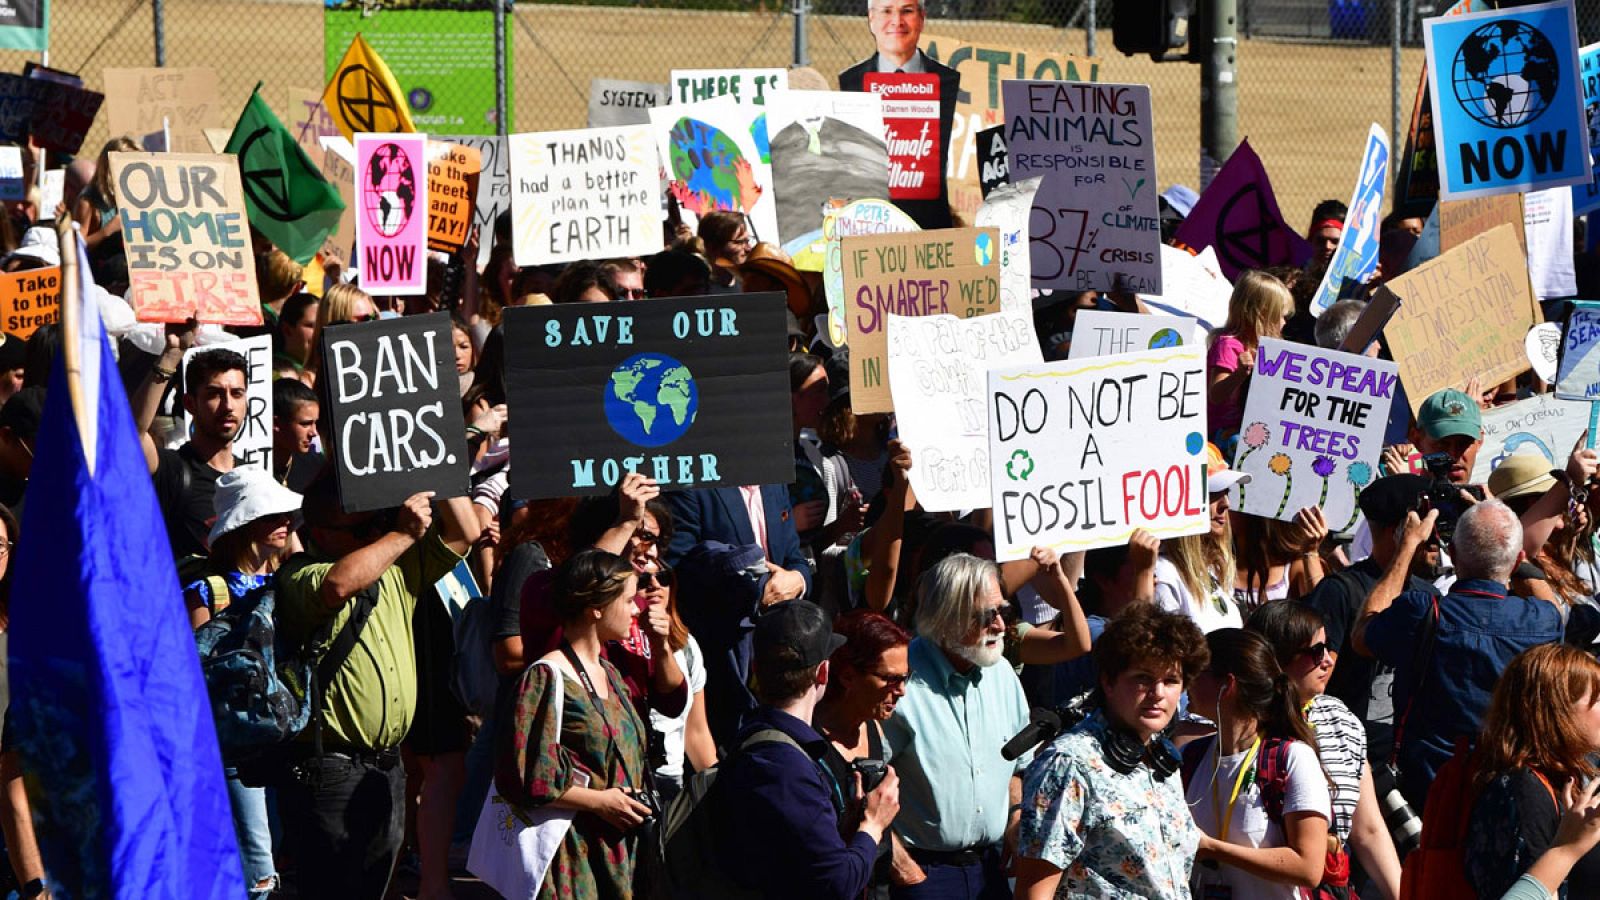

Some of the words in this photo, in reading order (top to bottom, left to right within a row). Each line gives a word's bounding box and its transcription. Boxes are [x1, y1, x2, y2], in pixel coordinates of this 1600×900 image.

[136, 74, 184, 104] ACT
[600, 89, 657, 108] SYSTEM
[677, 75, 740, 104] THERE
[870, 83, 934, 96] ExxonMobil
[1028, 84, 1136, 116] EATING
[136, 103, 209, 131] NOW
[911, 105, 934, 113] Woods
[669, 119, 708, 150] NOT
[883, 121, 934, 161] limate
[1010, 115, 1142, 147] ANIMALS
[441, 150, 466, 164] ake
[546, 136, 627, 166] THANOS
[1016, 153, 1146, 171] RESPONSIBLE
[1071, 145, 1083, 153] IS
[1459, 129, 1567, 185] NOW
[675, 148, 736, 181] COOL
[888, 160, 925, 188] illain
[119, 162, 228, 209] OUR
[428, 179, 472, 201] treets
[492, 183, 510, 198] FO
[519, 175, 549, 194] had
[562, 179, 571, 191] a
[585, 169, 639, 192] better
[1075, 174, 1106, 187] FOR
[432, 199, 458, 215] and
[551, 193, 589, 215] plan
[600, 195, 610, 210] 4
[620, 188, 649, 207] the
[121, 207, 246, 249] HOME
[428, 214, 464, 238] TAY!
[549, 214, 631, 255] EARTH
[1102, 212, 1160, 232] CLIMATE
[131, 245, 182, 270] IS
[190, 247, 244, 269] ON
[365, 245, 417, 283] NOW
[853, 249, 870, 279] IF
[875, 244, 908, 274] YOU
[914, 242, 955, 271] WERE
[1100, 247, 1154, 264] CRISIS
[1465, 236, 1499, 282] AIR
[16, 276, 57, 293] Take
[133, 271, 249, 313] FIRE
[1076, 270, 1096, 290] BE
[1105, 271, 1157, 294] VEGAN
[13, 298, 30, 312] to
[36, 293, 60, 308] the
[856, 278, 949, 334] SMARTER
[958, 275, 998, 305] WE'D
[8, 309, 60, 330] Street
[545, 314, 634, 348] SAVE
[672, 308, 741, 340] OUR
[1573, 311, 1591, 326] THE
[988, 316, 1030, 356] the
[1093, 327, 1140, 356] THE
[1568, 322, 1600, 350] SEA
[244, 347, 268, 384] E
[331, 330, 440, 403] BAN
[862, 356, 881, 387] IN
[1258, 346, 1308, 383] WE
[1306, 355, 1398, 400] SPEAK
[994, 387, 1048, 442] DO
[1068, 373, 1148, 429] NOT
[1158, 369, 1204, 421] BE
[1585, 382, 1600, 399] AN
[1280, 388, 1326, 419] FOR
[1326, 396, 1373, 429] THE
[342, 401, 457, 477] CARS.
[1081, 432, 1103, 470] A
[1280, 419, 1361, 461] TREES
[571, 453, 721, 488] MOTHER
[1001, 475, 1117, 546] FOSSIL
[1121, 461, 1208, 527] FOOL!
